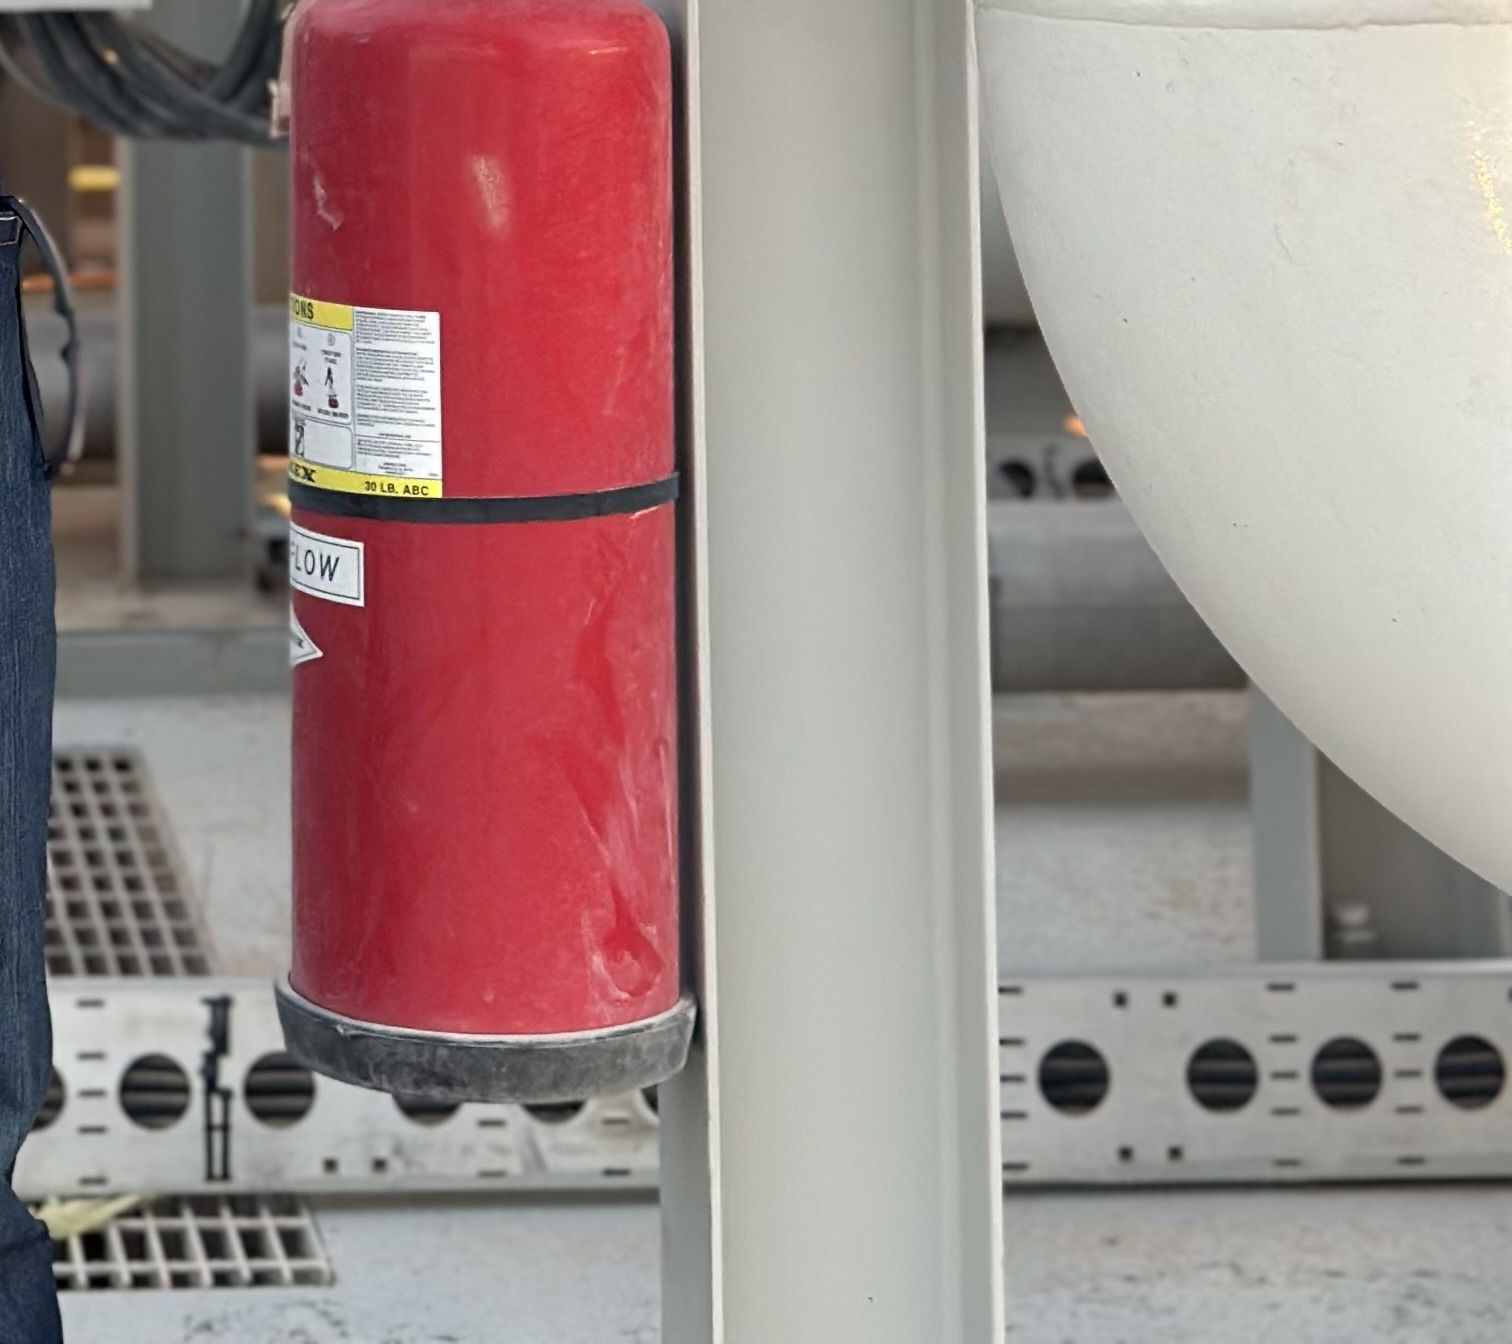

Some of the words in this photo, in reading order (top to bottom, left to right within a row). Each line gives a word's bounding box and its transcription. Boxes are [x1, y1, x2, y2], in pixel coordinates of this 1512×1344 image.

[364, 481, 377, 491] 30
[380, 483, 399, 494] LB.
[403, 485, 429, 496] ABC
